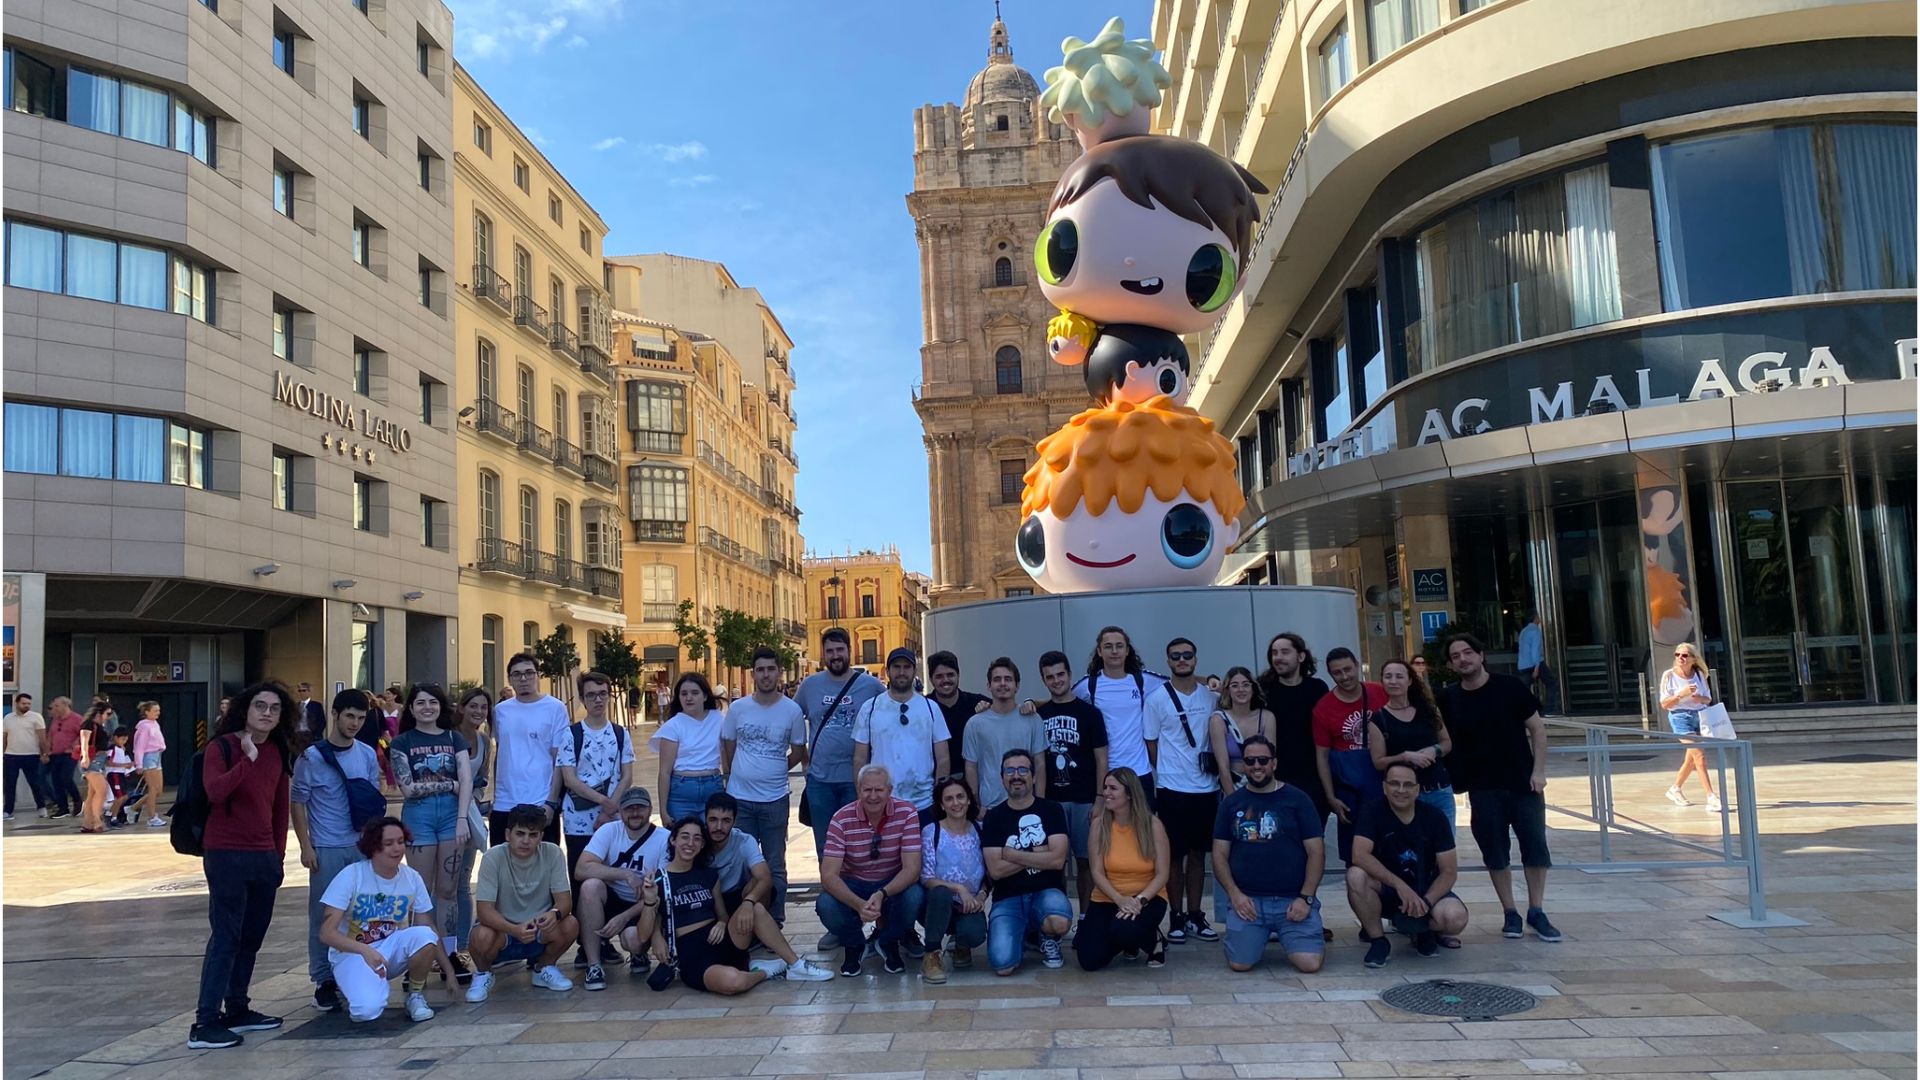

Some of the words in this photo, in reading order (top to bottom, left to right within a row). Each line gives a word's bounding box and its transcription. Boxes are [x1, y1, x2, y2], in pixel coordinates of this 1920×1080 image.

[275, 370, 357, 431] MOLINA
[364, 409, 412, 453] LARIO
[1288, 426, 1390, 480] HOTEL
[1416, 397, 1493, 447] AC
[1527, 346, 1855, 425] MALAGA
[1418, 572, 1444, 587] AC
[1427, 613, 1441, 629] H
[173, 665, 182, 678] P
[1042, 715, 1078, 732] GHETTO
[1341, 710, 1362, 733] HUGO
[673, 888, 713, 907] MALIBU
